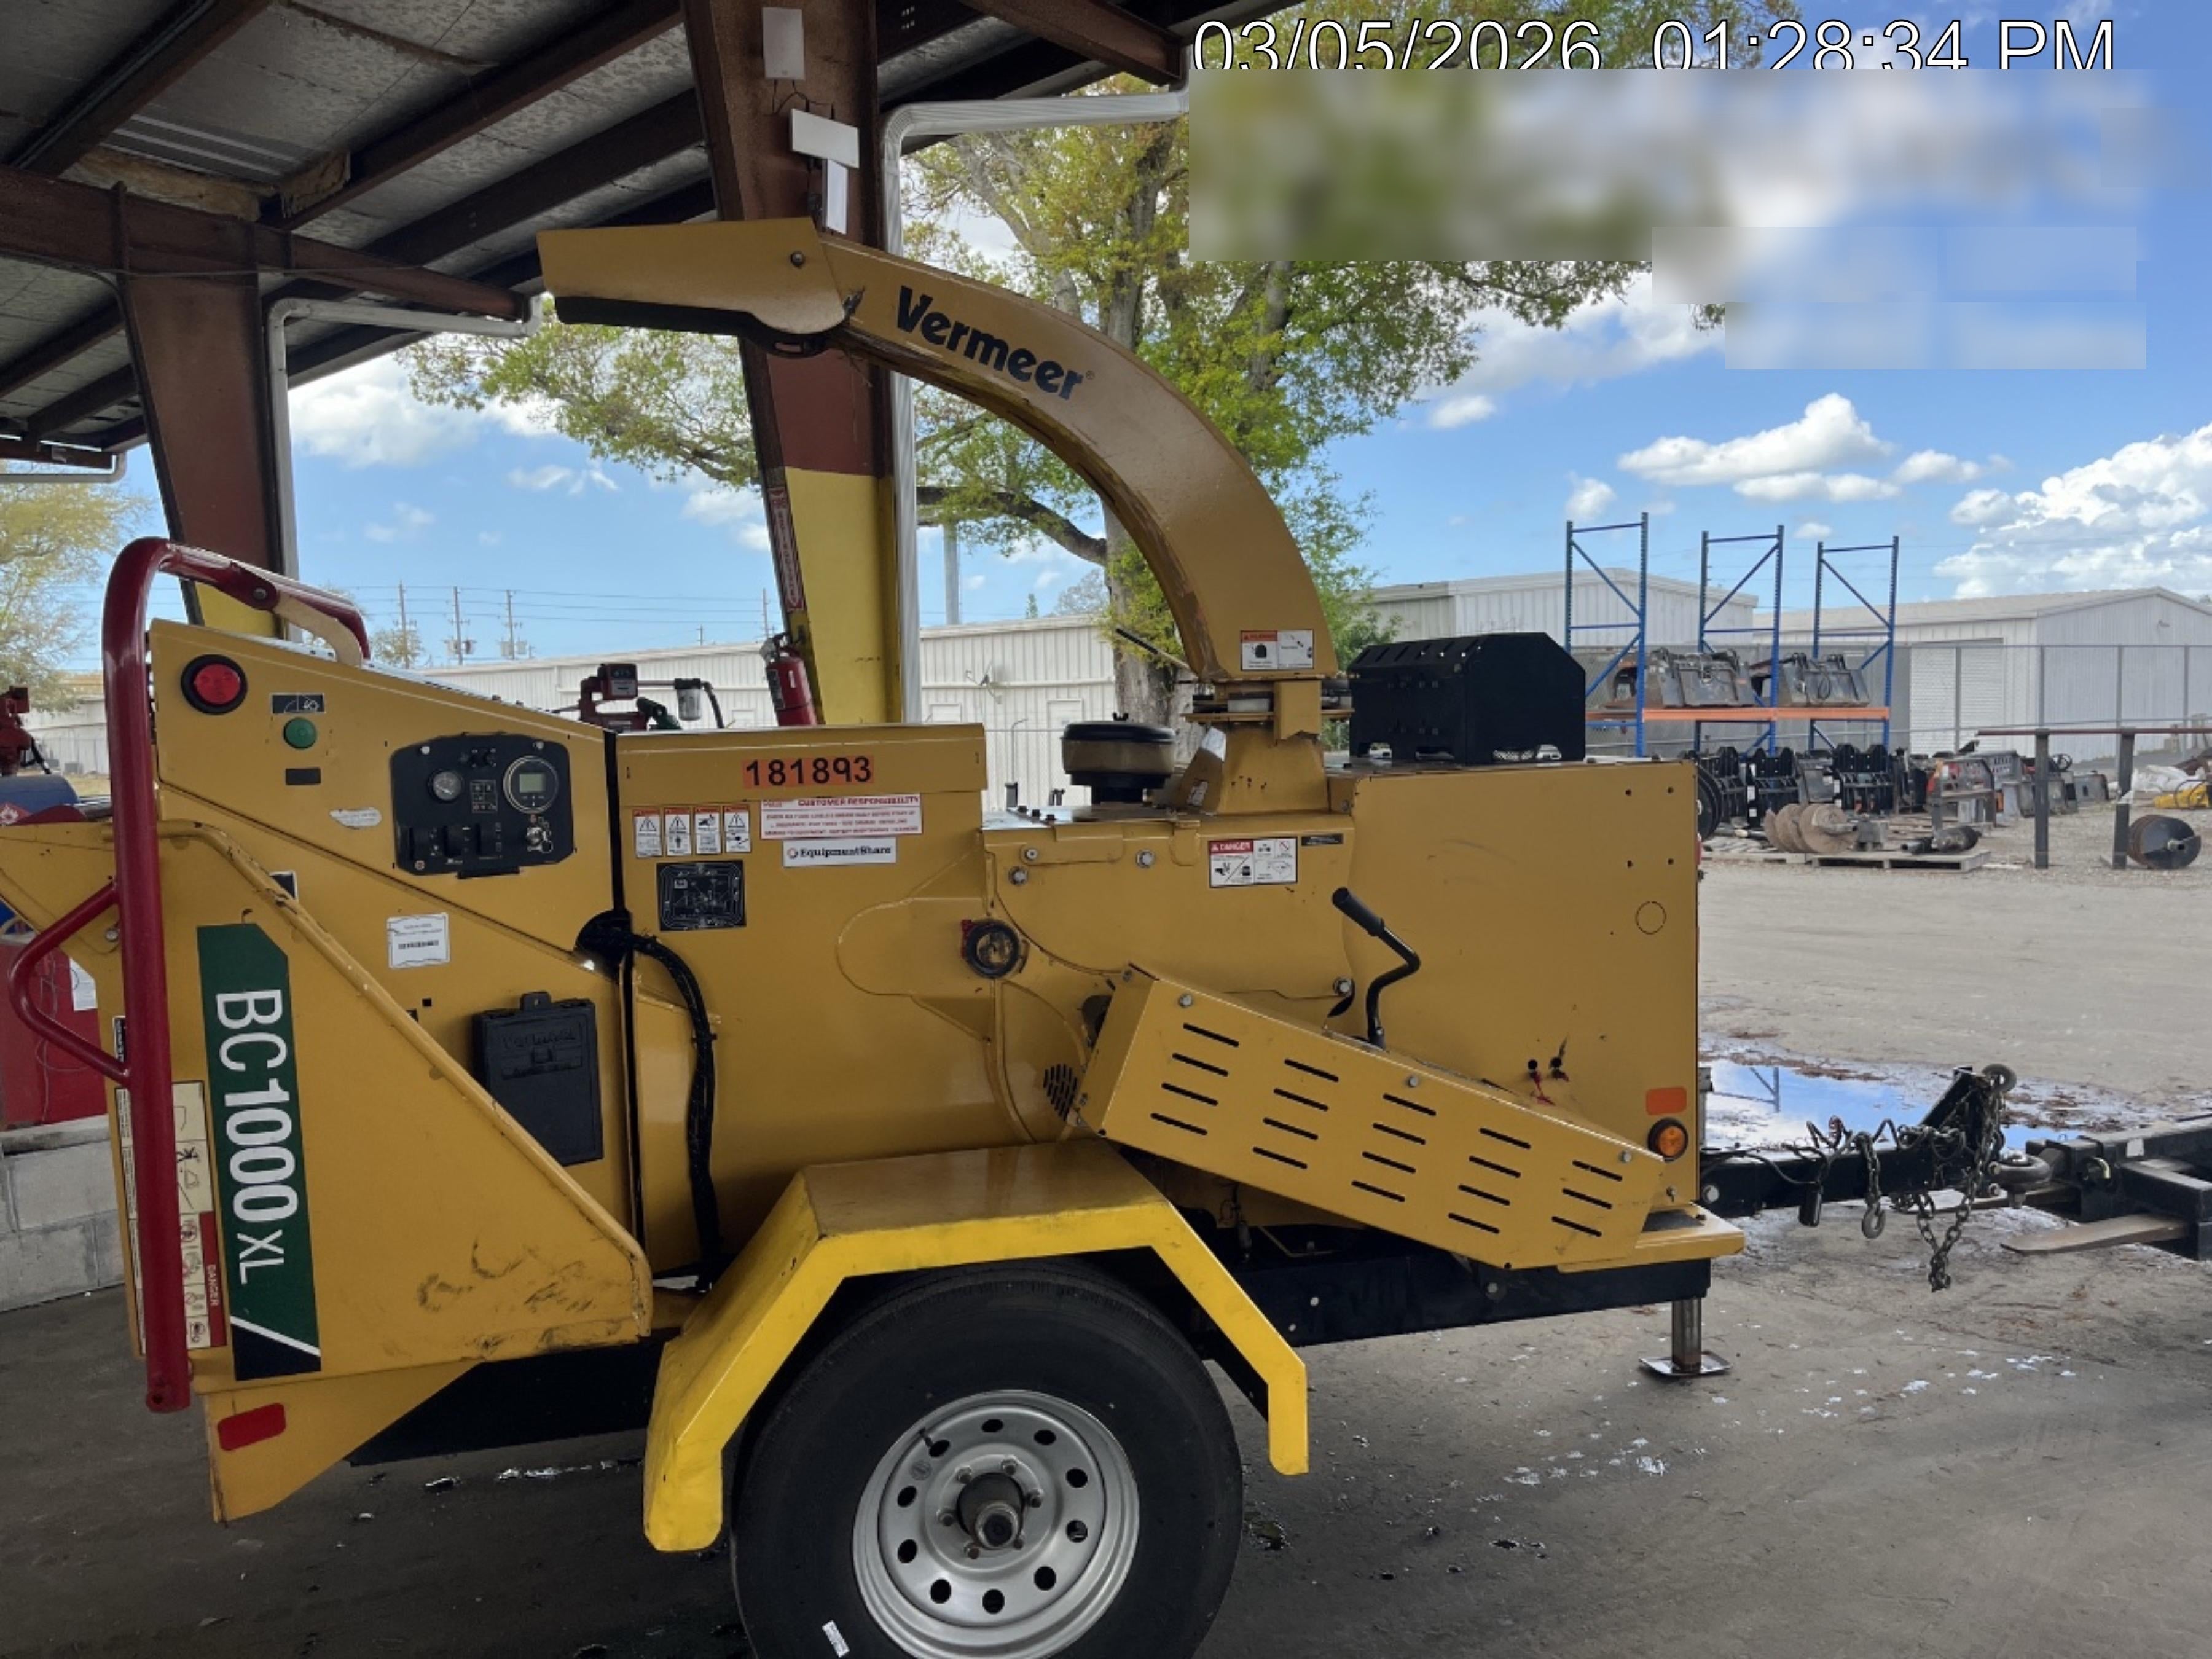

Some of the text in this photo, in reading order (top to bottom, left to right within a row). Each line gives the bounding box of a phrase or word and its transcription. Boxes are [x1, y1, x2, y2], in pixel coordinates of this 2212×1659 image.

[898, 286, 1083, 399] Vermeer
[746, 756, 871, 786] 181893
[800, 846, 891, 858] EquipmentShare
[206, 1263, 219, 1306] DANGER
